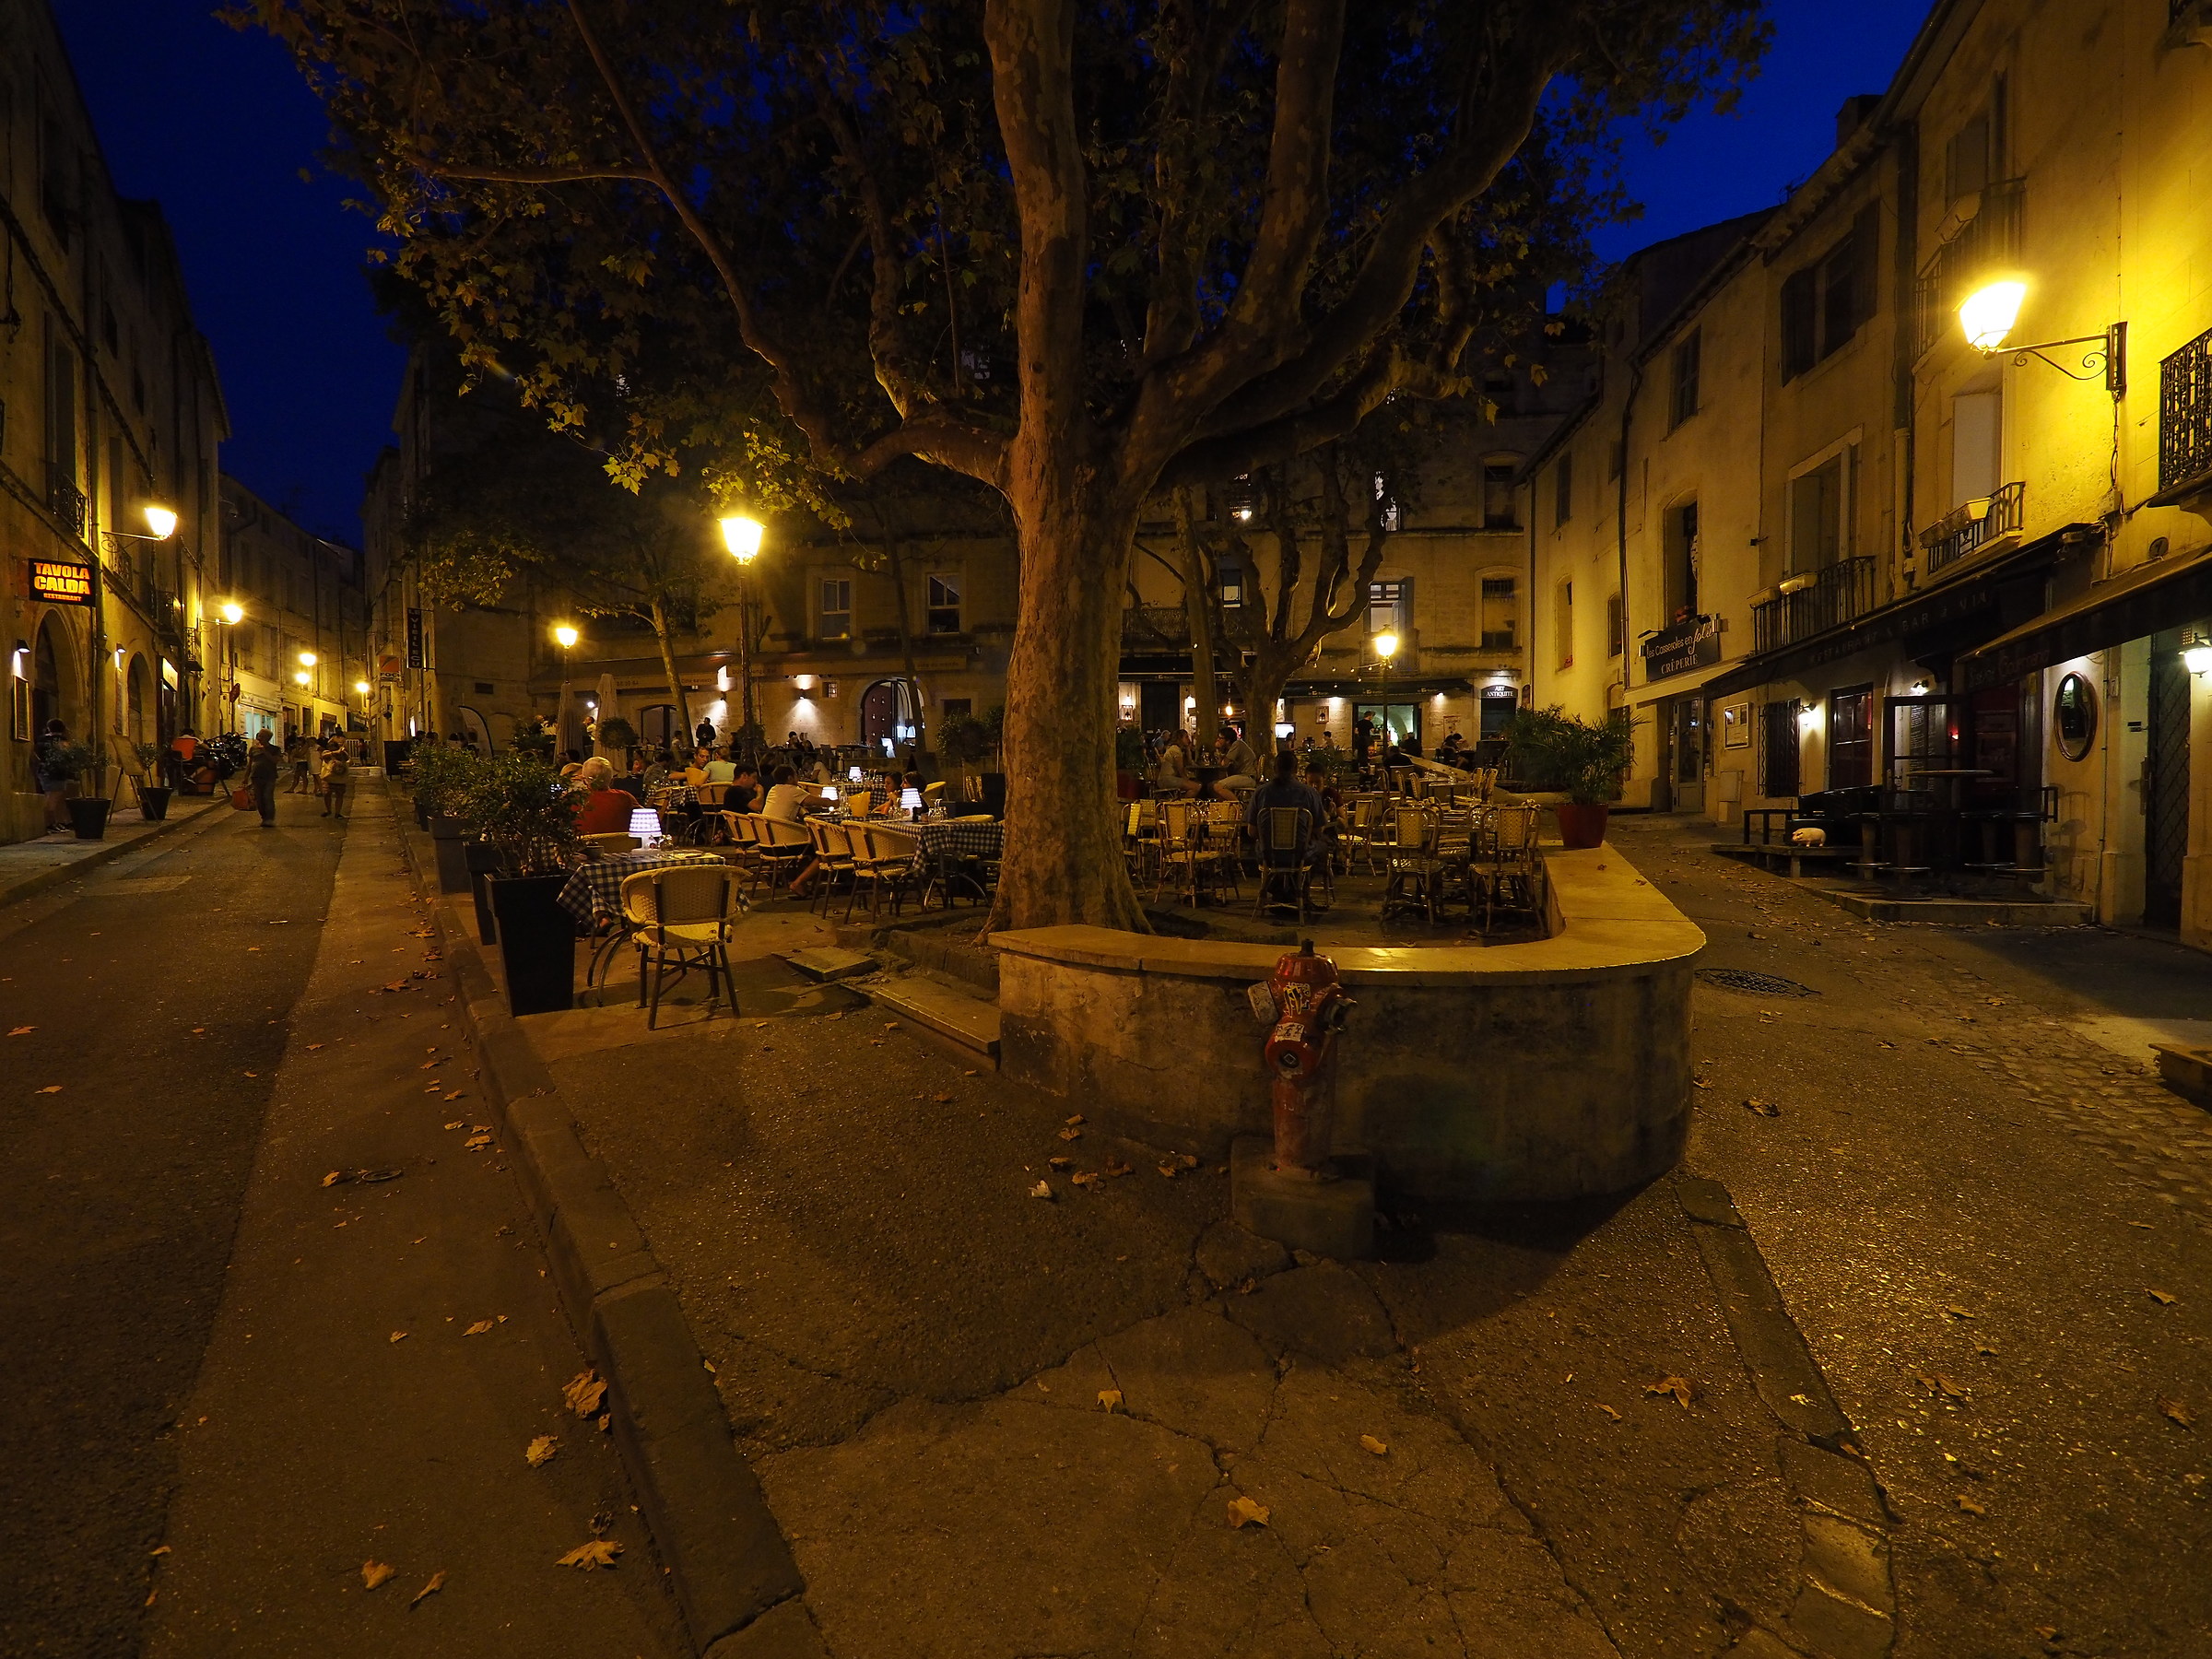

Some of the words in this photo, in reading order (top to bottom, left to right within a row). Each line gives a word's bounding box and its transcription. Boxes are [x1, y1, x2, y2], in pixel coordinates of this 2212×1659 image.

[34, 563, 89, 579] TAVOLA
[34, 576, 90, 594] CALDA
[43, 593, 82, 601] RESTAURANT
[1902, 612, 1929, 632] BAR
[1655, 636, 1685, 656] Casseroles
